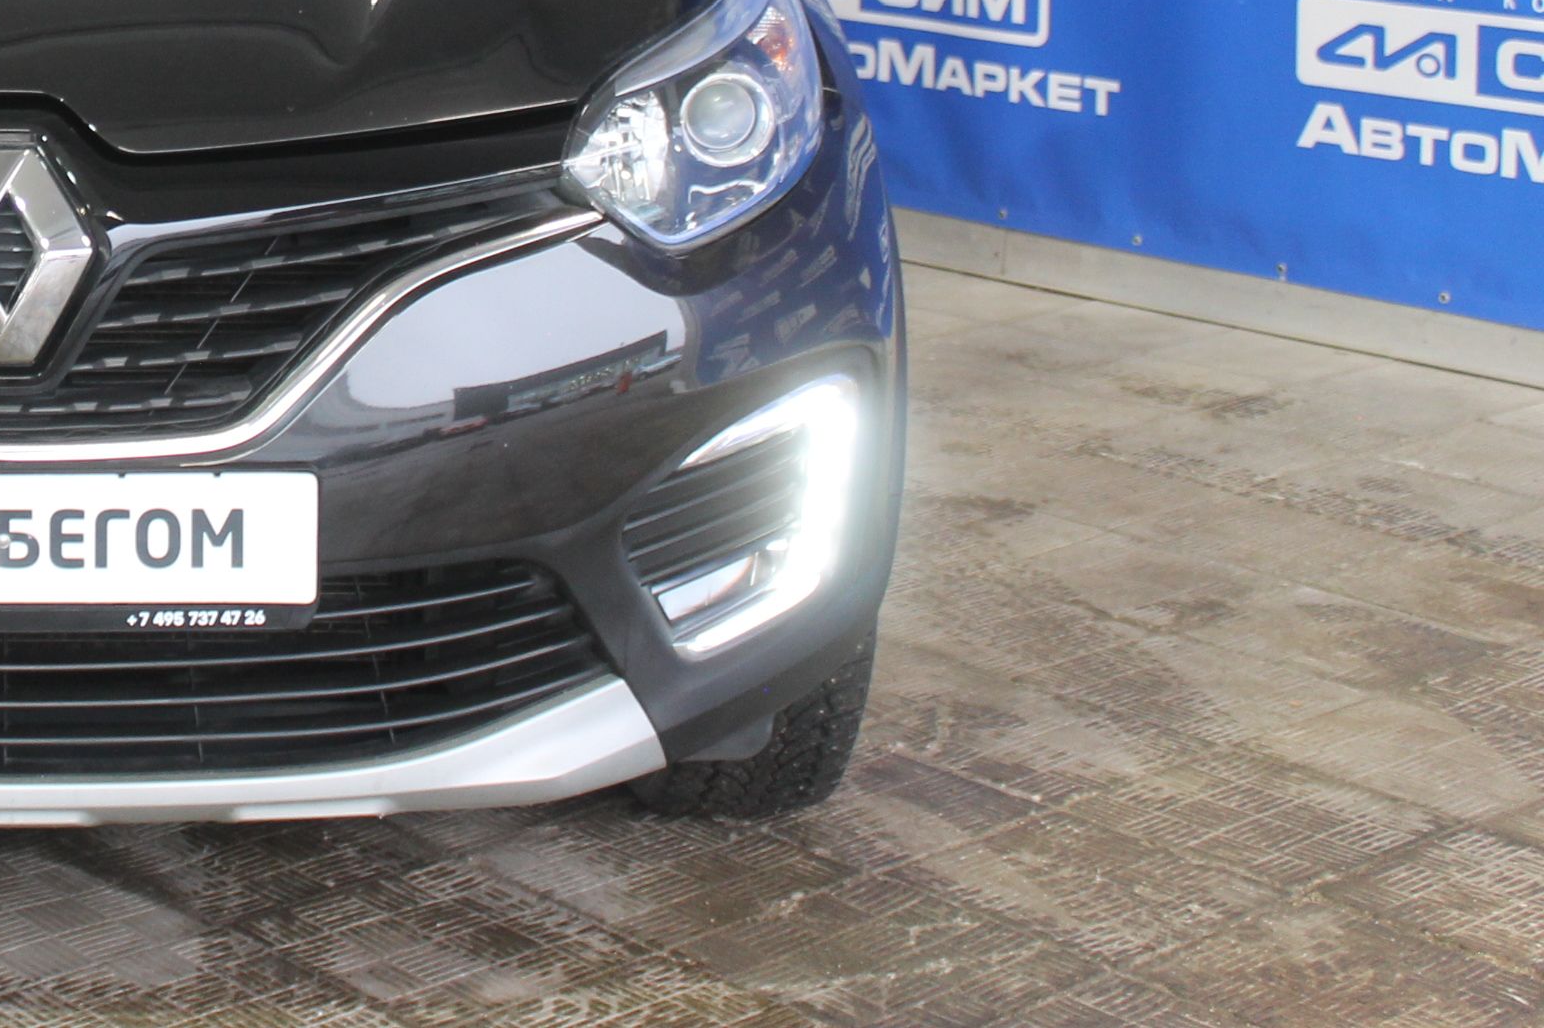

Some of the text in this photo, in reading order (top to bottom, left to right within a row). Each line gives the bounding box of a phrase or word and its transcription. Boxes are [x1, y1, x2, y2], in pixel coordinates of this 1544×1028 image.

[153, 611, 185, 627] 495
[188, 610, 219, 626] 737
[220, 610, 242, 626] 47
[244, 610, 267, 626] 26
